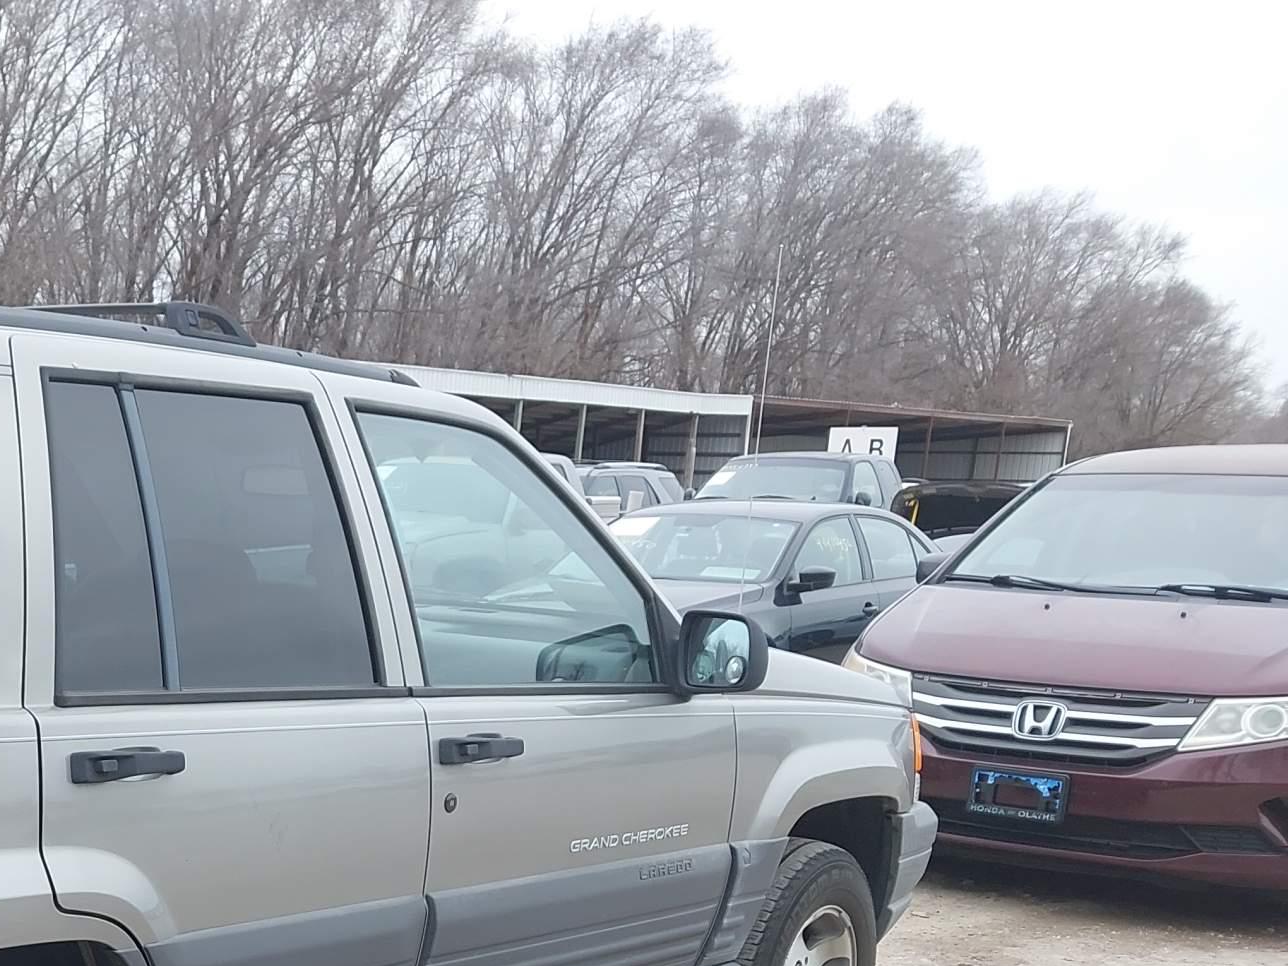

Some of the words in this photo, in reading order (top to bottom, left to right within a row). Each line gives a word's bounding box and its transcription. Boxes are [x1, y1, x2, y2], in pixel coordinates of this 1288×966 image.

[970, 802, 1006, 815] HONDA
[570, 834, 619, 853] GRAND
[621, 823, 689, 845] CHEROKEE
[639, 860, 693, 880] LAREDO
